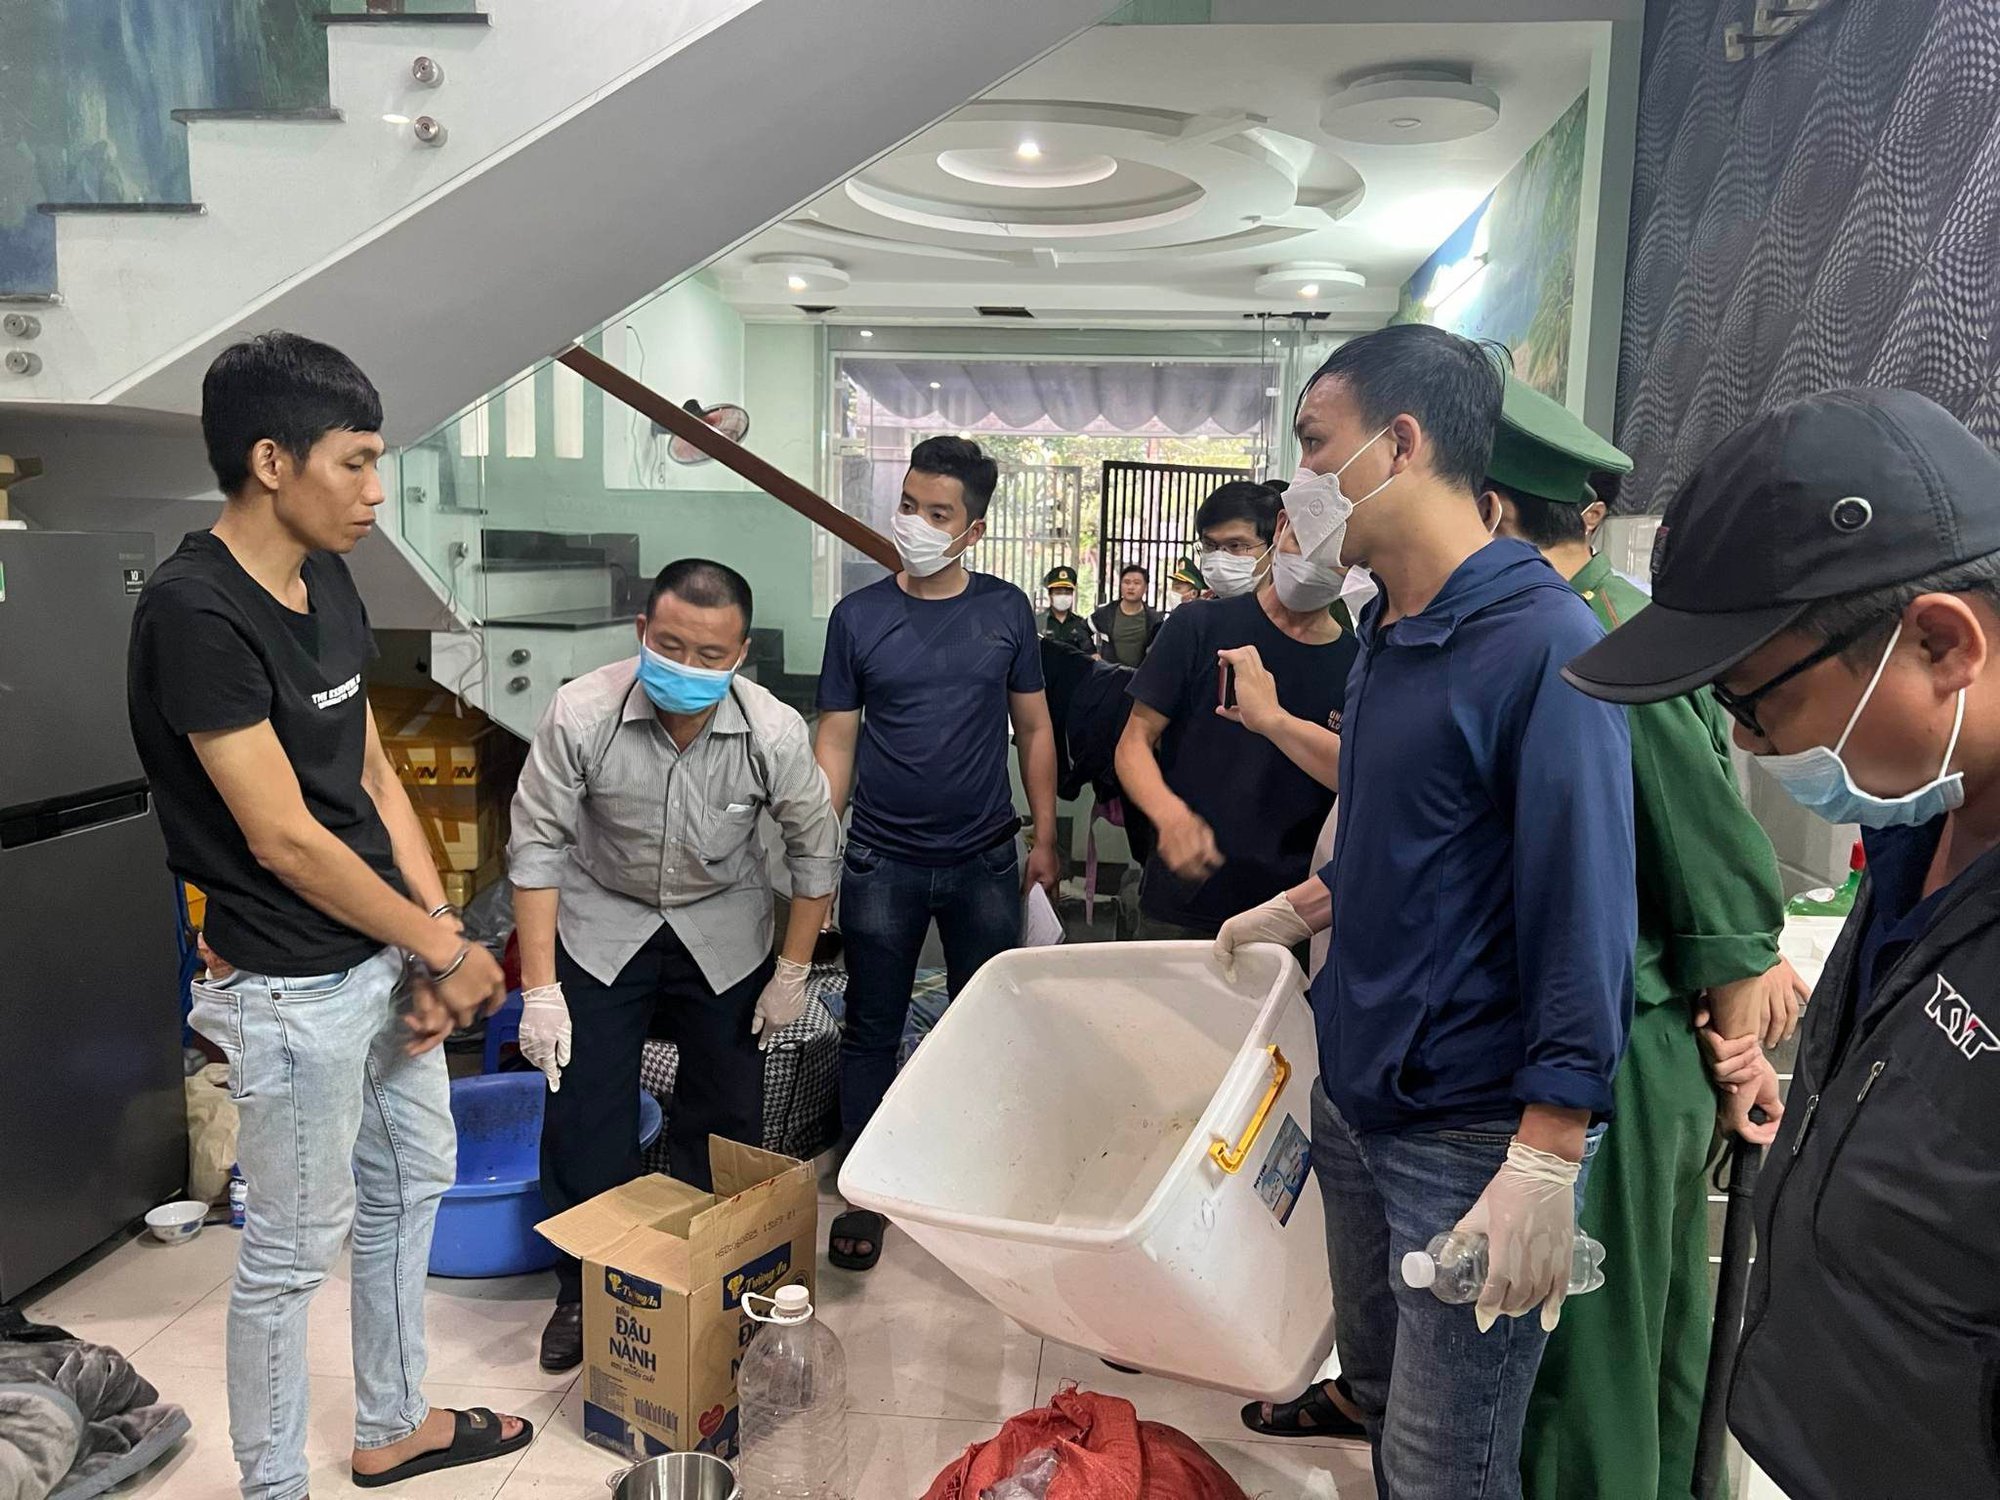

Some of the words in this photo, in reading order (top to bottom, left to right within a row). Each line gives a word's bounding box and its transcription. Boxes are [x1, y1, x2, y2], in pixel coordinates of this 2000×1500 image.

[1924, 973, 2000, 1060] KYT
[616, 1316, 650, 1345] ĐẬU
[609, 1336, 656, 1372] NÀNH
